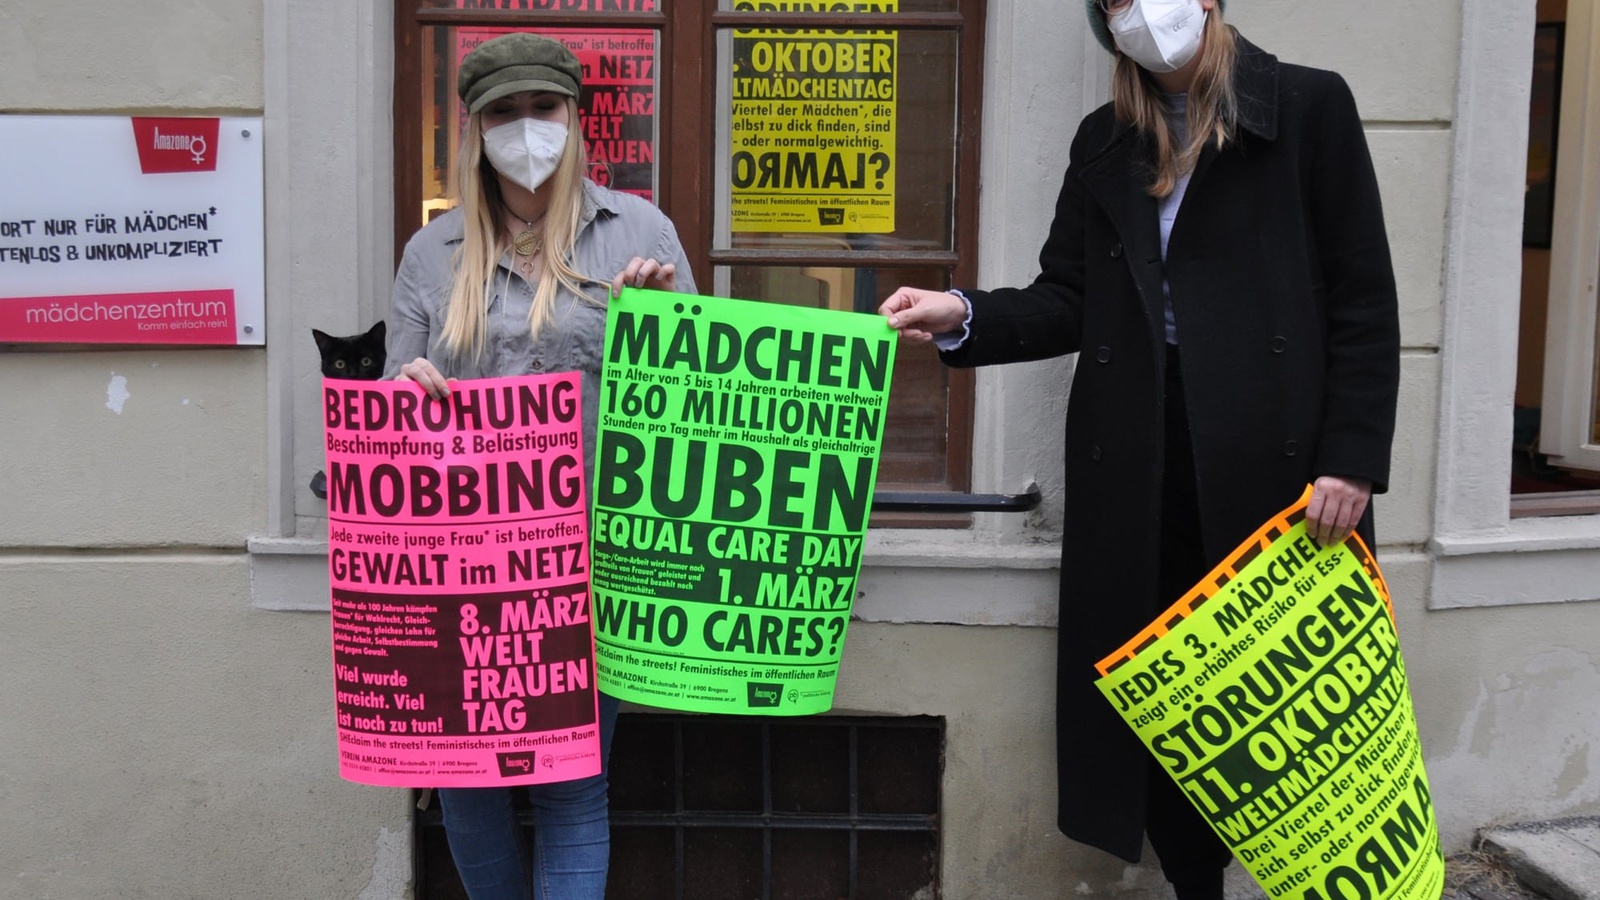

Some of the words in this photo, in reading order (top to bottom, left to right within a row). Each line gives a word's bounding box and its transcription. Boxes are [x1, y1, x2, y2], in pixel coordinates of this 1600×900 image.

[592, 38, 605, 49] ist
[751, 41, 892, 73] OKTOBER
[777, 103, 798, 116] der
[872, 104, 892, 117] die
[154, 126, 190, 150] Amazone
[769, 121, 782, 132] zu
[787, 120, 812, 132] dick
[817, 120, 860, 134] finden,
[864, 120, 890, 132] sind
[742, 135, 770, 147] oder
[775, 135, 884, 150] normalgewichtig.
[830, 198, 869, 206] öffentlichen
[0, 219, 36, 238] ORT
[44, 218, 78, 237] NUR
[85, 213, 118, 234] FÜR
[66, 245, 80, 260] &
[85, 238, 223, 263] UNKOMPLIZIERT
[26, 298, 227, 323] mädchenzentrum
[137, 321, 169, 331] Komm
[170, 320, 206, 330] einfach
[207, 319, 228, 329] rein!
[609, 302, 890, 392] MÄDCHEN
[607, 366, 621, 379] im
[625, 368, 655, 384] Alter
[658, 373, 680, 386] von
[684, 375, 691, 387] 5
[695, 374, 713, 389] bis
[718, 377, 732, 390] 14
[736, 379, 777, 395] Jahren
[780, 385, 830, 402] arbeiten
[834, 391, 883, 407] weltweit
[325, 380, 577, 432] BEDROHUNG
[606, 380, 668, 420] 160
[681, 388, 881, 442] MILLIONEN
[327, 432, 445, 460] Beschimpfung
[452, 436, 466, 455] &
[473, 430, 578, 454] Belästigung
[603, 415, 645, 430] Stunden
[648, 422, 666, 435] pro
[670, 423, 689, 438] Tag
[693, 426, 721, 440] mehr
[724, 428, 738, 441] im
[741, 430, 790, 447] Haushalt
[793, 435, 809, 448] als
[812, 438, 876, 455] gleichaltrige
[330, 455, 581, 517] MOBBING
[597, 429, 874, 532] BUBEN
[331, 526, 353, 543] Jede
[357, 530, 399, 546] zweite
[404, 532, 445, 550] junge
[496, 529, 513, 543] ist
[518, 522, 584, 542] betroffen.
[595, 511, 694, 555] EQUAL
[707, 526, 790, 564] CARE
[801, 535, 861, 568] DAY
[332, 548, 449, 586] GEWALT
[460, 558, 496, 586] im
[508, 542, 585, 582] NETZ
[650, 560, 666, 568] wird
[667, 561, 688, 571] immer
[689, 564, 705, 572] noch
[658, 570, 687, 580] geleistet
[610, 573, 649, 585] ausreichend
[650, 577, 676, 588] bezahlt
[677, 581, 693, 590] noch
[610, 581, 656, 595] wertgeschätzt.
[718, 568, 743, 605] 1.
[756, 566, 854, 610] MÄRZ
[357, 602, 367, 610] als
[368, 603, 381, 611] 100
[382, 604, 405, 613] Jahren
[406, 605, 438, 614] kämpfen
[366, 614, 403, 625] Wahlrecht,
[404, 616, 431, 625] Gleich-
[459, 603, 490, 635] 8.
[500, 589, 589, 633] MÄRZ
[374, 626, 403, 635] gleichen
[405, 626, 423, 636] Lohn
[424, 627, 436, 636] für
[594, 591, 688, 647] WHO
[703, 610, 845, 657] CARES?
[363, 647, 388, 657] Gewalt.
[375, 637, 438, 648] Selbstbestimmung
[459, 631, 544, 668] WELT
[1132, 699, 1168, 729] zeigt
[1169, 683, 1194, 707] ein
[1194, 633, 1256, 687] erhöhtes
[1253, 593, 1297, 636] Risiko
[1294, 574, 1318, 597] für
[1315, 551, 1345, 577] Ess-
[336, 663, 359, 683] Viel
[362, 670, 408, 687] wurde
[463, 658, 589, 700] FRAUEN
[612, 669, 648, 684] AMAZONE
[625, 654, 639, 665] the
[642, 660, 677, 671] streets!
[680, 662, 748, 678] Feministisches
[750, 668, 762, 678] im
[764, 668, 815, 680] öffentlichen
[817, 669, 836, 679] Raum
[1111, 650, 1186, 712] JEDES
[1183, 633, 1218, 660] 3.
[1151, 569, 1378, 774] STÖRUNGEN
[337, 691, 390, 709] erreicht.
[393, 693, 425, 711] Viel
[338, 709, 351, 727] ist
[354, 714, 385, 732] noch
[389, 720, 407, 733] zu
[411, 717, 443, 733] tun!
[462, 699, 528, 733] TAG
[1184, 766, 1253, 815] 11.
[1248, 616, 1398, 772] OKTOBER
[373, 738, 387, 749] the
[389, 740, 423, 750] streets!
[427, 740, 495, 750] Feministisches
[498, 739, 510, 748] im
[513, 733, 569, 748] öffentlichen
[571, 730, 595, 741] Raum
[1215, 649, 1407, 843] WELTMÄDCHENTAG
[341, 750, 360, 762] VEREIN
[361, 755, 397, 766] AMAZONE
[1239, 835, 1277, 864] Drei
[1274, 792, 1331, 840] Viertel
[1330, 772, 1355, 799] der
[1256, 853, 1288, 881] sich
[1289, 818, 1335, 861] selbst
[1335, 803, 1354, 823] zu
[1355, 773, 1385, 805] dick
[1269, 864, 1318, 898] unter-
[1320, 831, 1355, 863] oder
